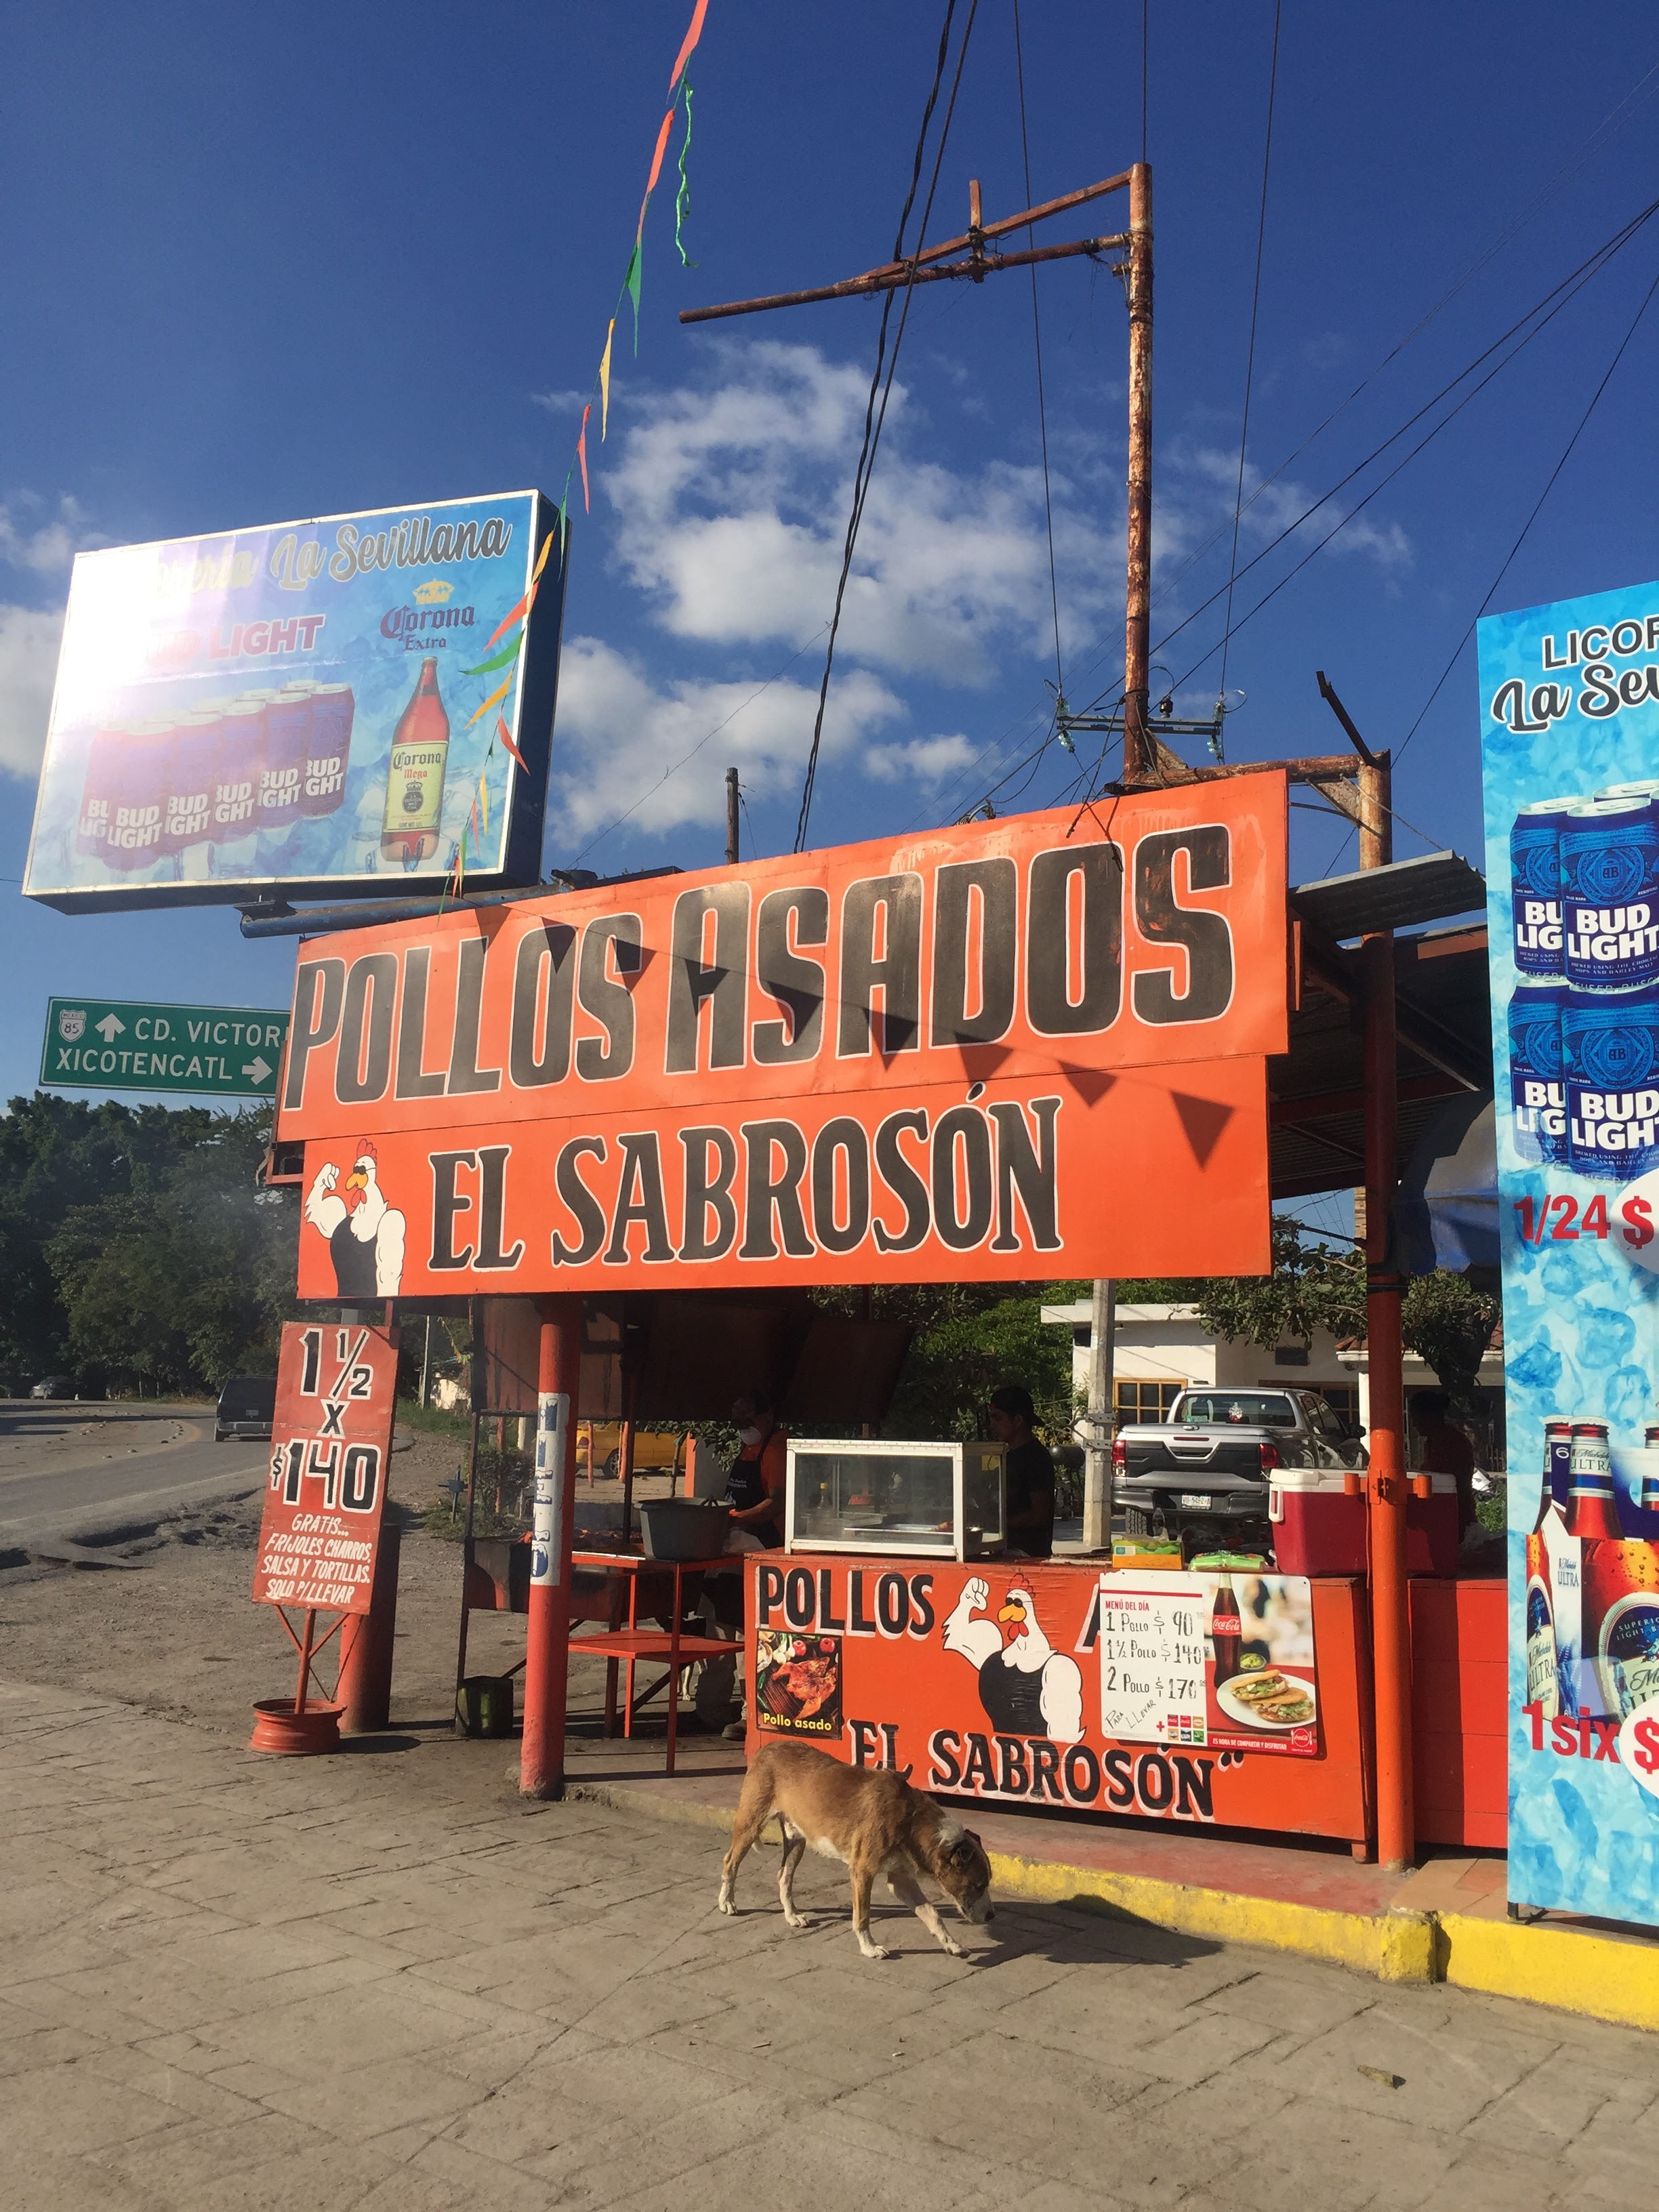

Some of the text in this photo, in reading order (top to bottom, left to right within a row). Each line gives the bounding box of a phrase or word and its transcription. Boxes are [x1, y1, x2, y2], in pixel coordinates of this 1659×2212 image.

[270, 533, 327, 590] La
[329, 516, 512, 582] Sevillana
[380, 605, 475, 640] Corona
[209, 614, 325, 660] LIGHT
[405, 634, 447, 651] Extra
[1490, 678, 1572, 734] La
[393, 751, 441, 771] Corona
[404, 769, 428, 779] Mega
[260, 768, 298, 788] BUD
[305, 773, 344, 796] GHT
[167, 794, 208, 815] BUD
[258, 783, 302, 808] IGHT
[116, 805, 159, 827] BUD
[164, 810, 211, 836] IGHT
[215, 798, 255, 823] GHT
[80, 817, 107, 838] LIG
[107, 822, 162, 848] LIGHT
[1525, 901, 1563, 925] BU
[1576, 903, 1651, 935] BUD
[1517, 923, 1563, 950] LIG
[1568, 924, 1659, 961] LIGHT
[282, 823, 1236, 1112] POLLOS ASADOS
[64, 1022, 79, 1034] 85
[135, 1017, 176, 1042] CD.
[56, 1048, 232, 1080] XICOTENCATL
[1525, 1081, 1566, 1108] BU
[1580, 1090, 1659, 1121] BUD
[1516, 1105, 1566, 1135] LIG
[1571, 1118, 1659, 1151] LIGH
[427, 1081, 1064, 1273] EL SABROSÓN
[1514, 1194, 1655, 1250] 1/24 $
[316, 1399, 350, 1439] X
[270, 1438, 382, 1513] $140
[1570, 1458, 1612, 1472] ULTRA
[265, 1533, 323, 1556] FRIJOLES
[261, 1555, 300, 1576] SALSA
[301, 1559, 312, 1577] Y
[1557, 1570, 1580, 1587] ULTRA
[265, 1578, 295, 1599] SOLO
[756, 1565, 935, 1641] POLLOS
[1105, 1599, 1150, 1612] MENÚ DEL DÍA
[1107, 1611, 1115, 1631] 1
[1107, 1666, 1117, 1692] 2
[763, 1713, 832, 1731] Pollo asado
[846, 1719, 913, 1781] EL
